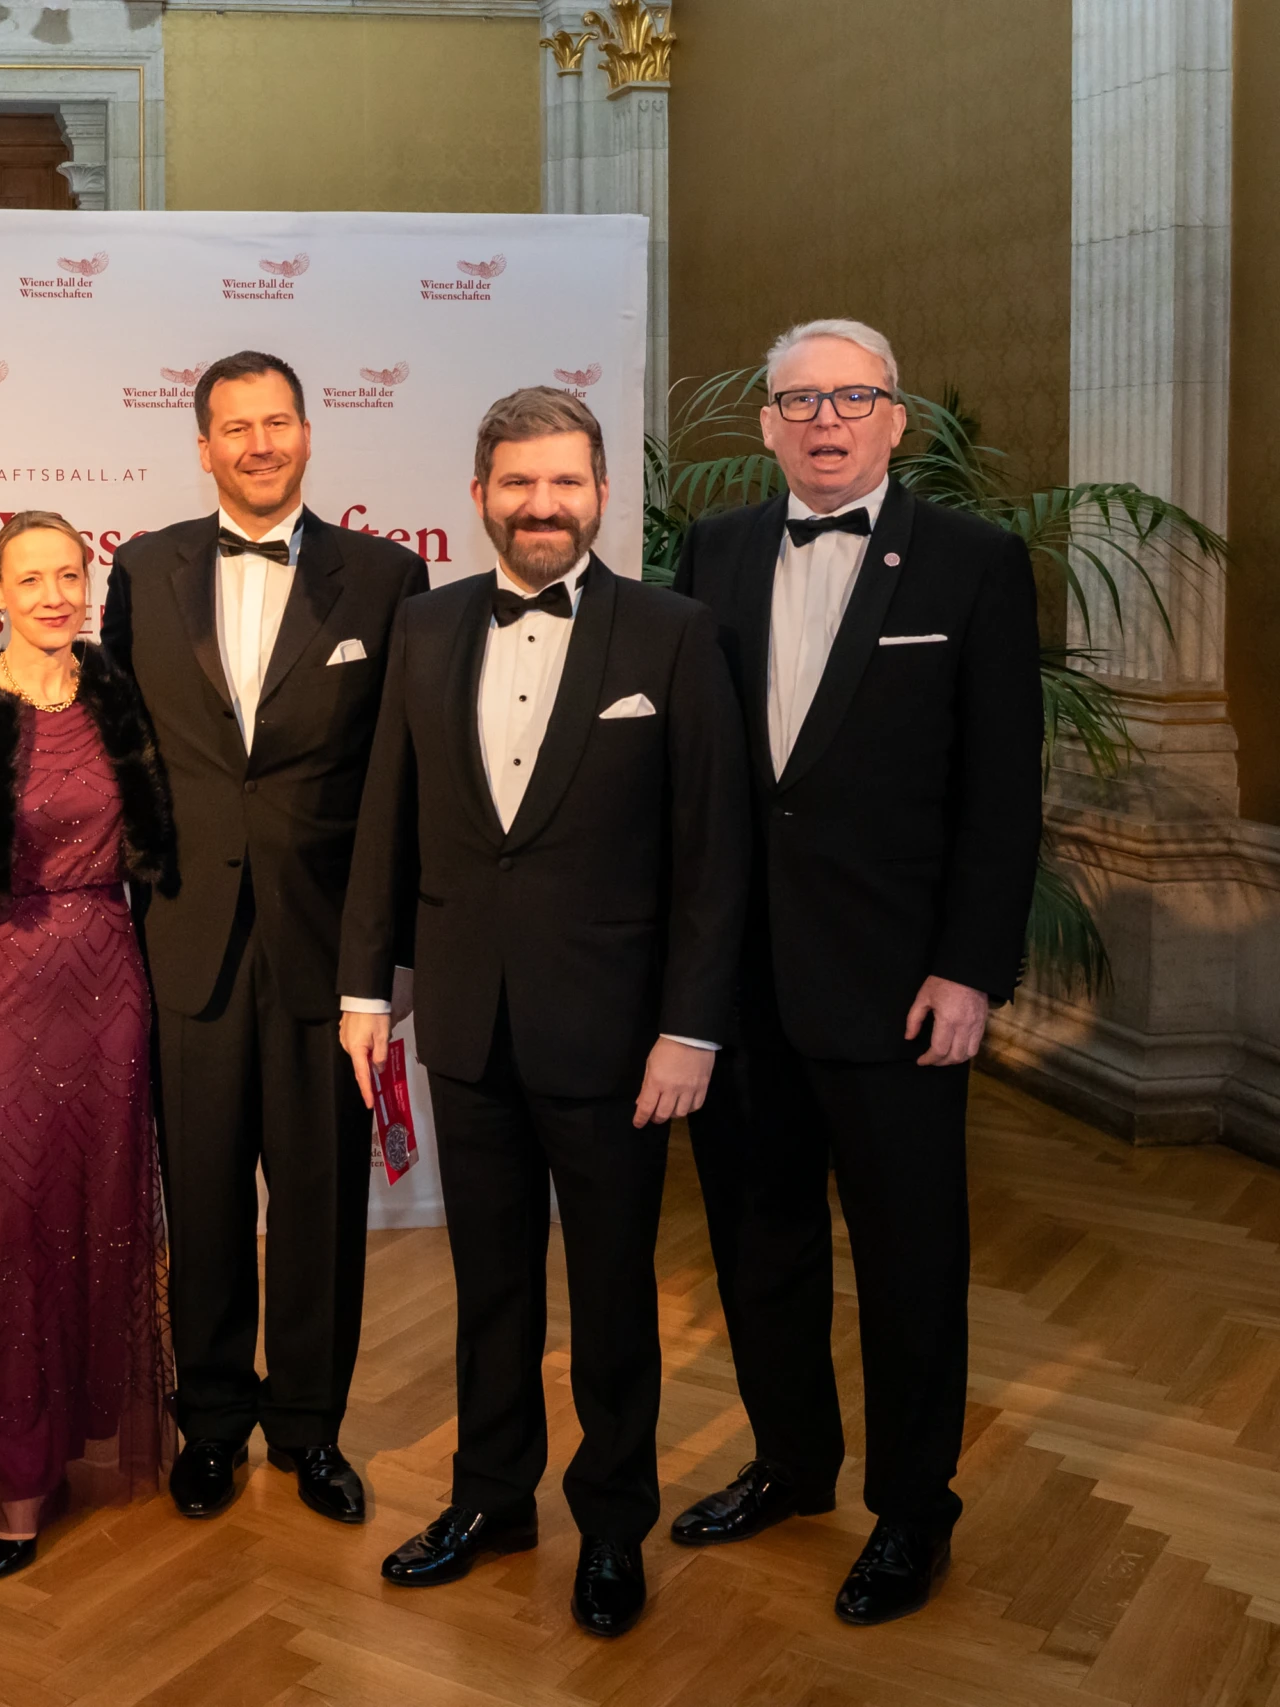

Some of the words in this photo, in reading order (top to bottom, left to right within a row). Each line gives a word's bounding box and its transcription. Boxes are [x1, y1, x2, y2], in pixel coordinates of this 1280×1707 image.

[19, 277, 55, 287] Wiener
[56, 277, 75, 287] Ball
[77, 277, 93, 287] der
[222, 279, 257, 288] Wiener
[258, 278, 277, 288] Ball
[279, 279, 294, 288] der
[420, 280, 454, 289] Wiener
[456, 280, 474, 290] Ball
[475, 280, 491, 290] der
[19, 288, 93, 298] Wissenschaften
[222, 290, 294, 300] Wissenschaften
[420, 290, 491, 301] Wissenschaften
[123, 387, 158, 397] Wiener
[159, 387, 178, 397] Ball
[323, 387, 357, 397] Wiener
[359, 387, 377, 397] Ball
[378, 387, 394, 397] der
[323, 398, 394, 408] Wissenschaften
